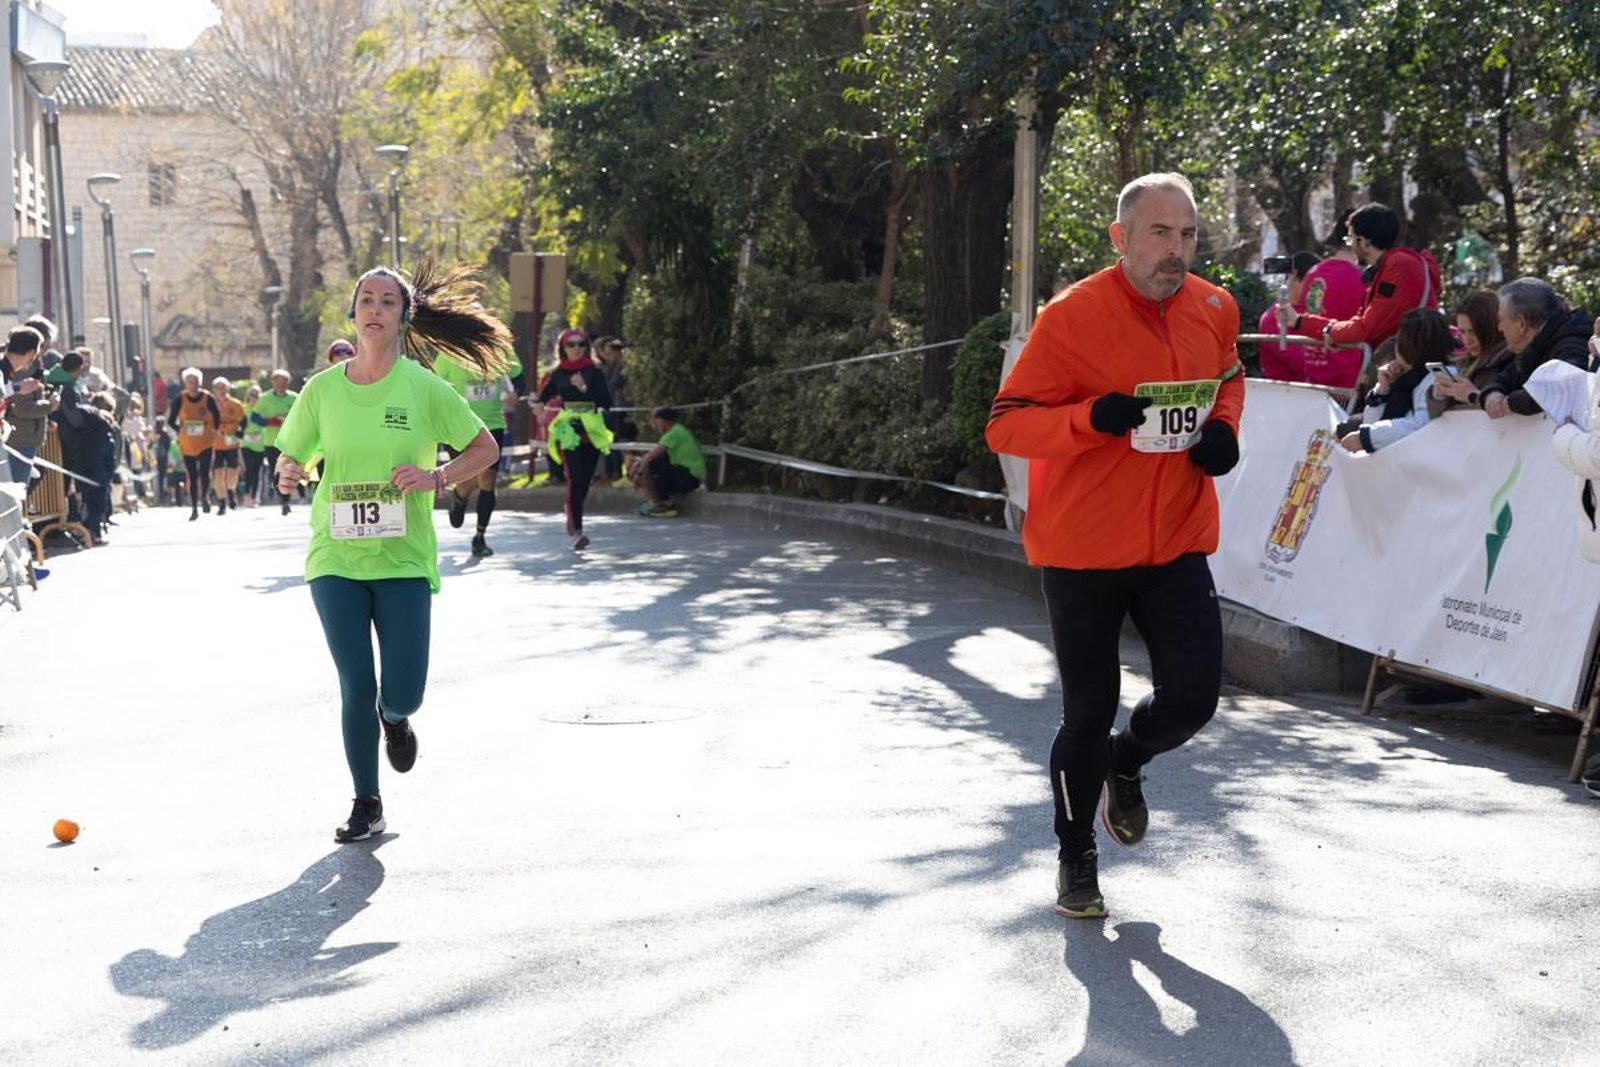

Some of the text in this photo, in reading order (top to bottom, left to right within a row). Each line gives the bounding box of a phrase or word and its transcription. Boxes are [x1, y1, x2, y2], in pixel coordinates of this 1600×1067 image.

[1160, 406, 1197, 435] 109
[352, 502, 380, 525] 113
[1445, 613, 1480, 636] Deportes
[1480, 622, 1491, 638] de
[1511, 609, 1522, 625] de
